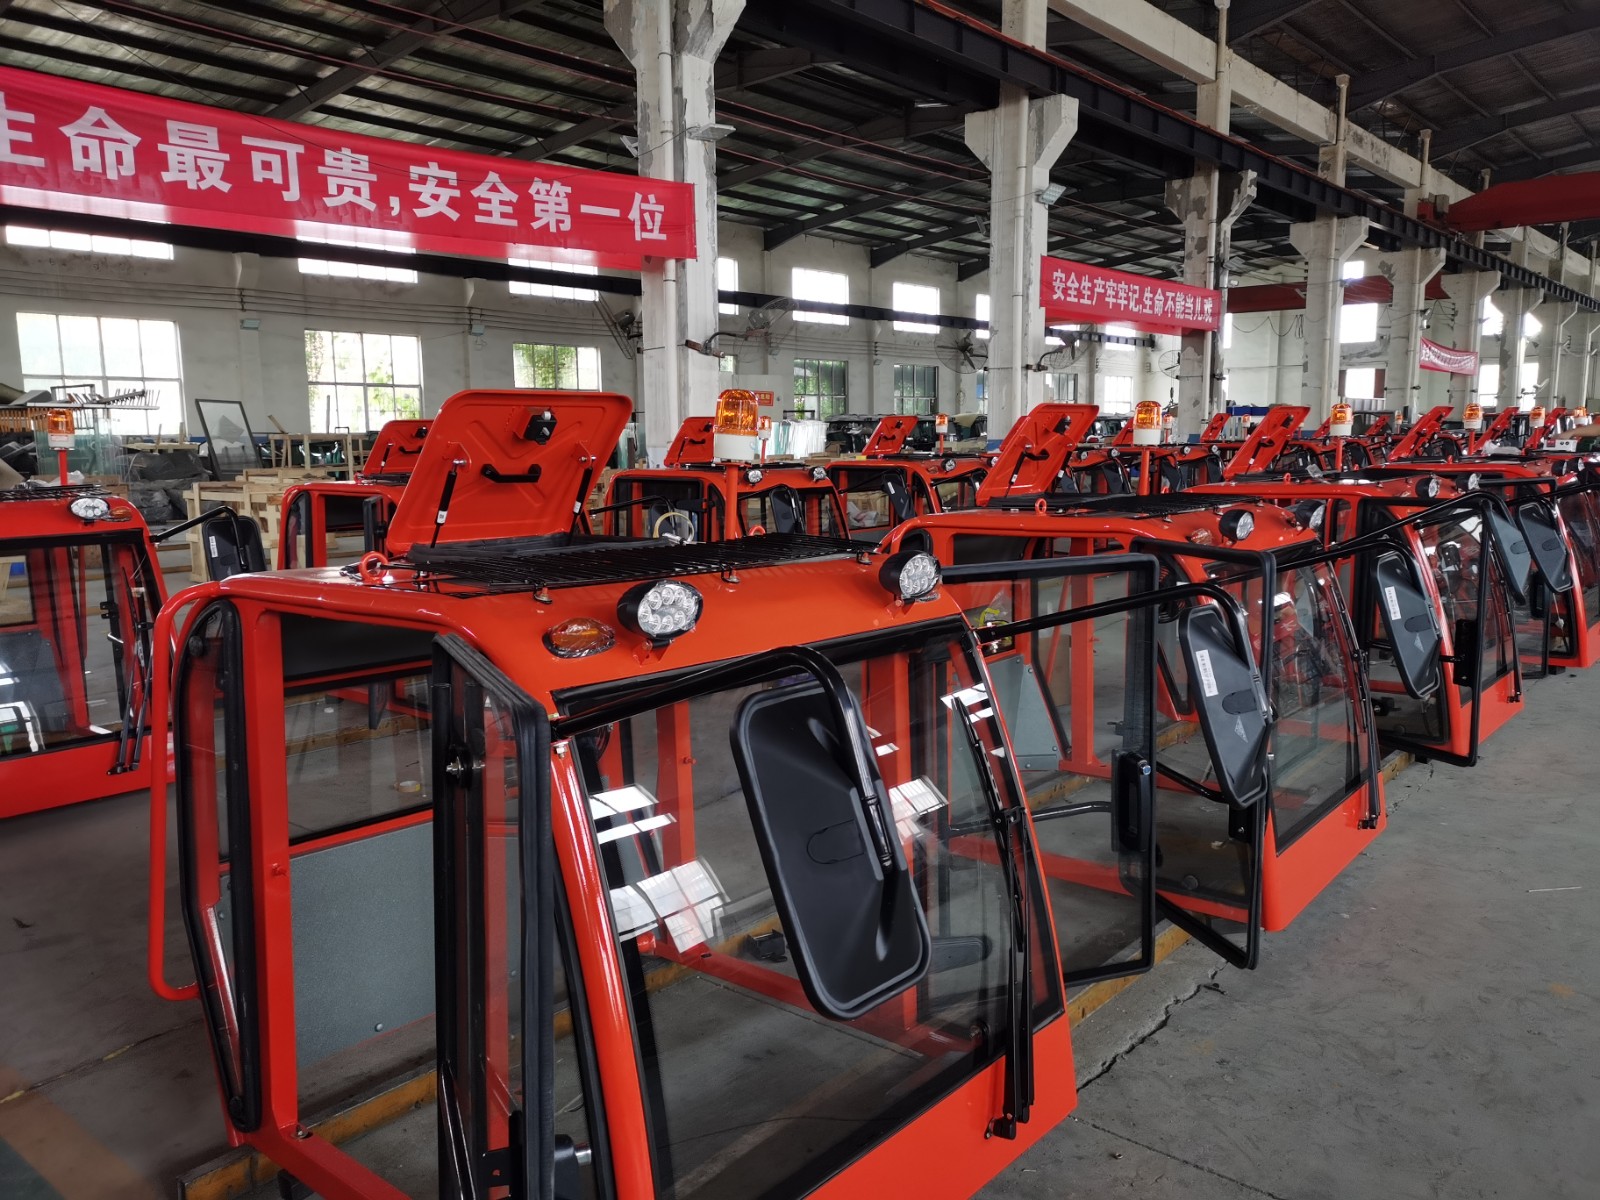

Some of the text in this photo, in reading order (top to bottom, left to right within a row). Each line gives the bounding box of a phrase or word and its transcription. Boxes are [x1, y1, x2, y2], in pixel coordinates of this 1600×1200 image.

[1052, 268, 1213, 323] 安全生产牢牢记,生命不能当儿戏
